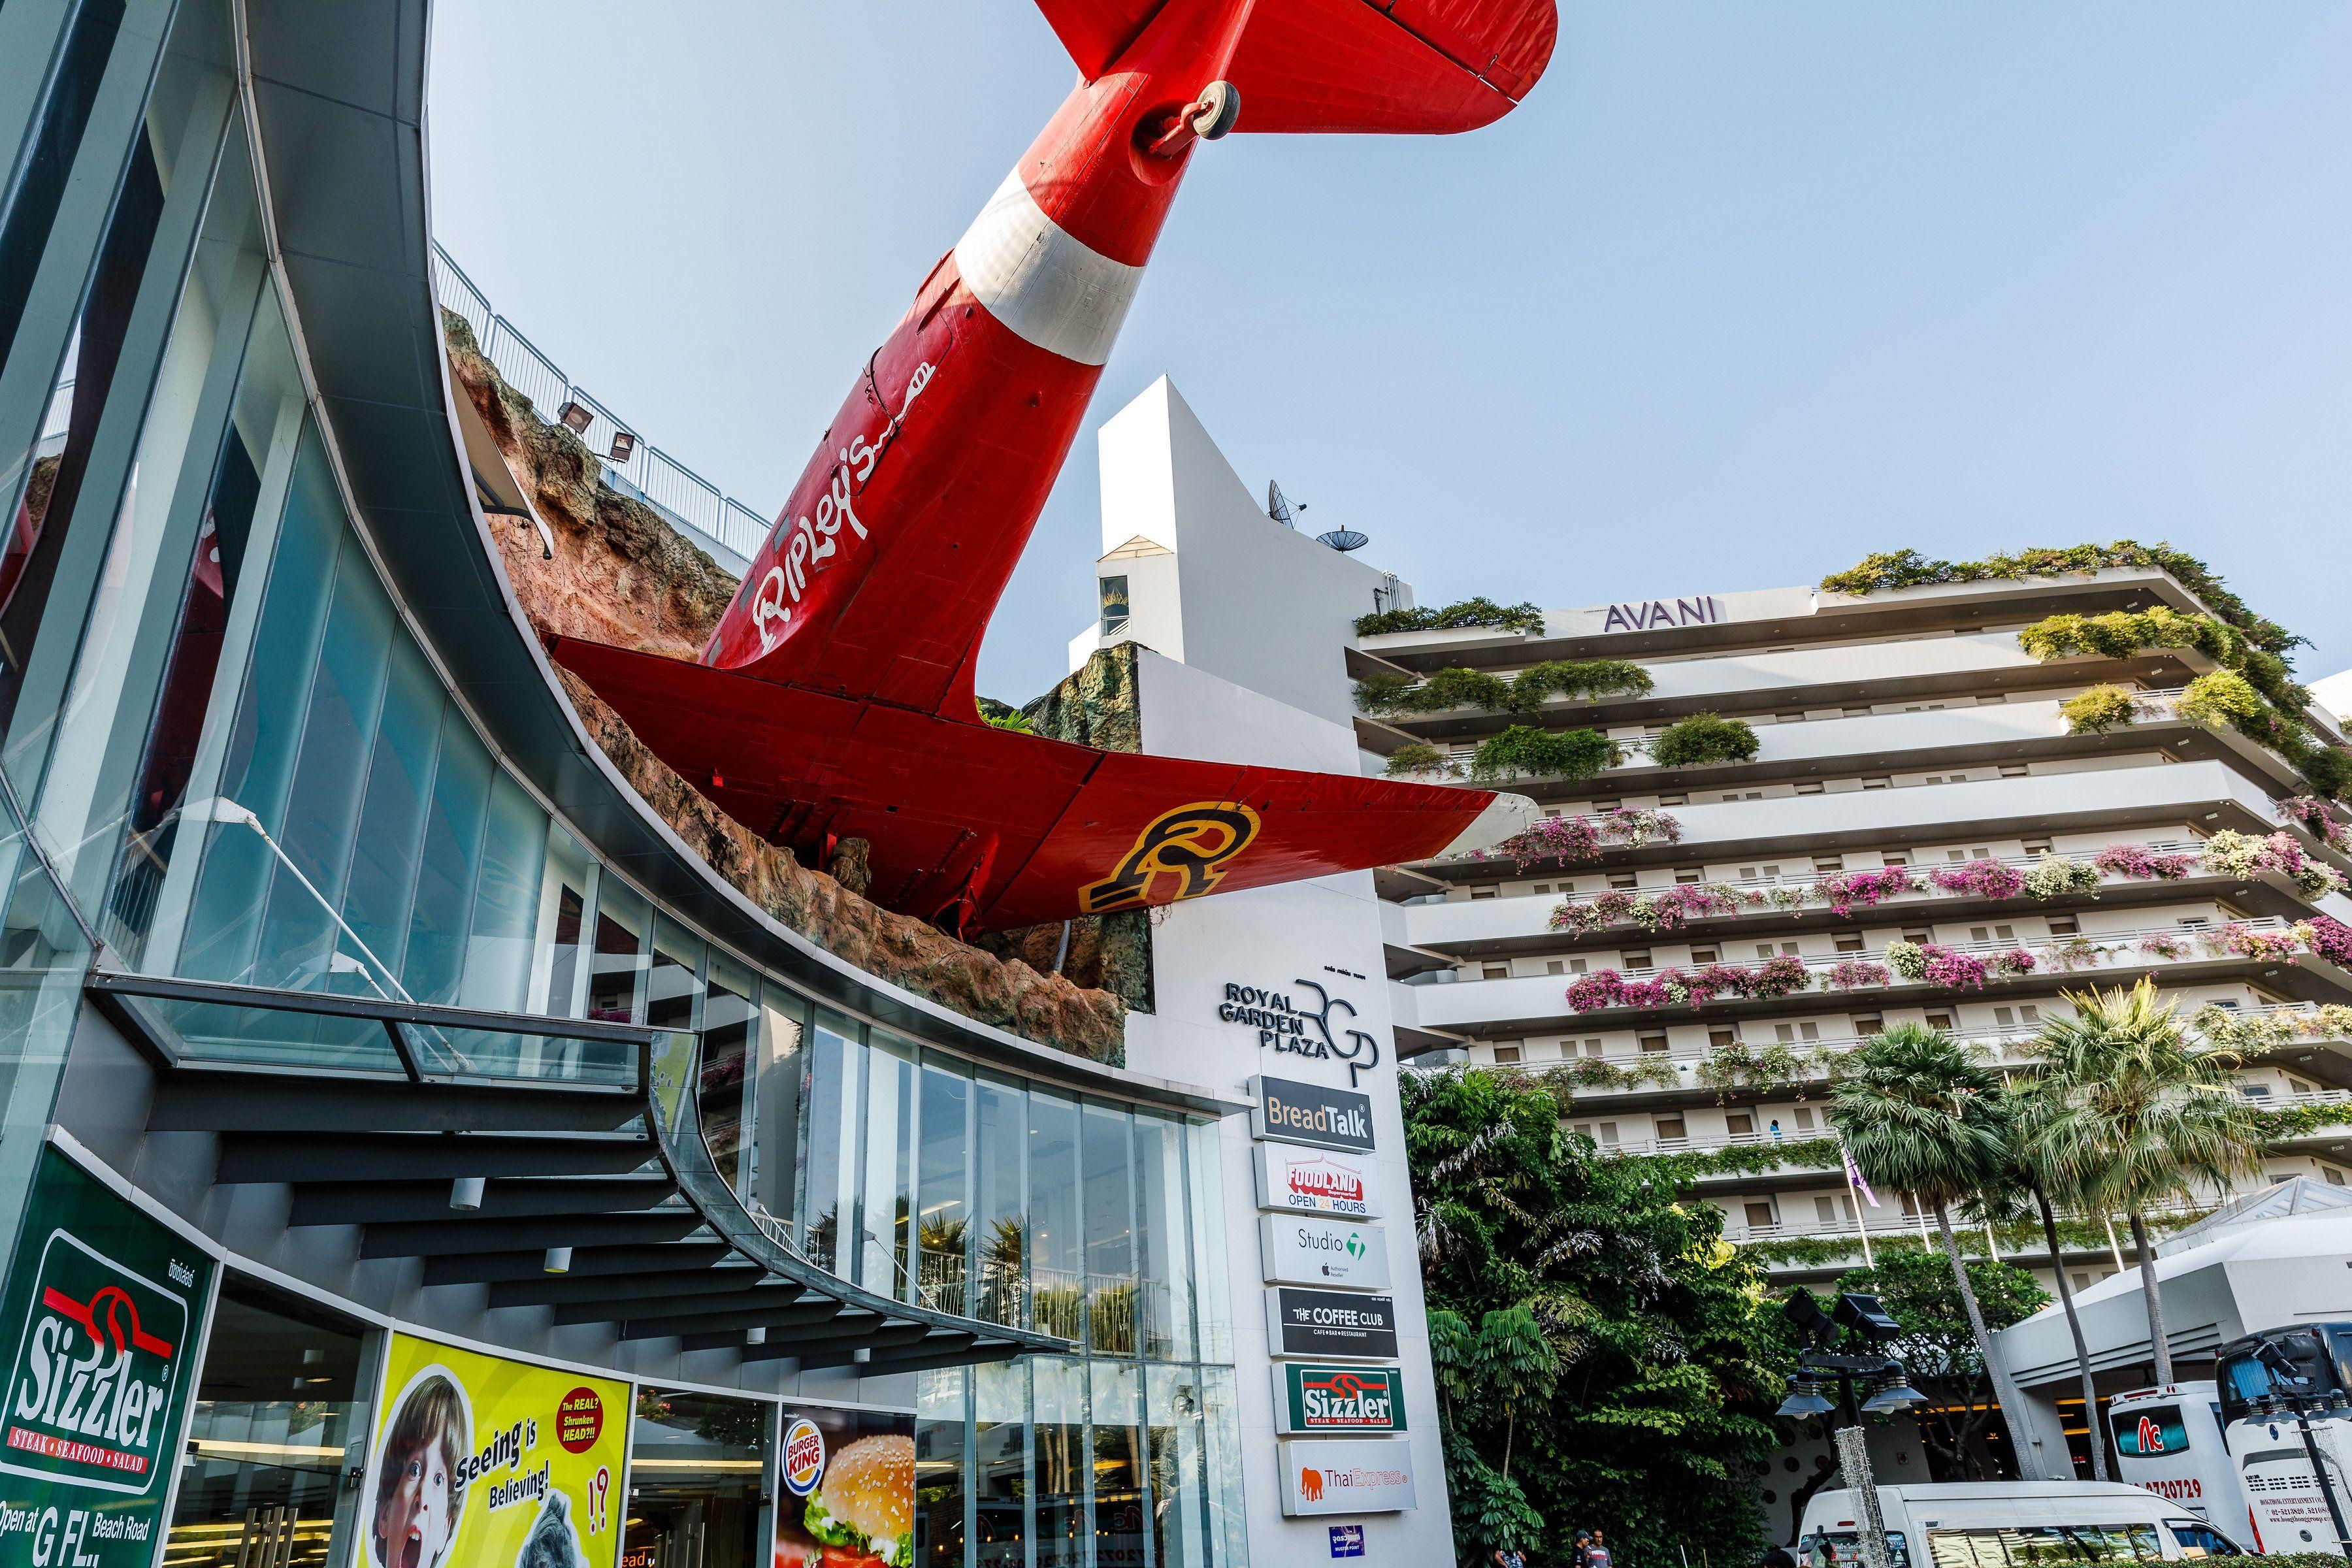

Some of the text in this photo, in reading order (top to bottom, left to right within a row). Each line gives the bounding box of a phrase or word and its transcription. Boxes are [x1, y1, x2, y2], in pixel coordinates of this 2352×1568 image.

[1604, 595, 1716, 632] AVANI
[1226, 982, 1298, 1014] ROYAL
[1219, 1002, 1304, 1036] GARDEN
[1260, 1030, 1330, 1060] PLAZA
[1268, 1096, 1368, 1138] BreadTalk
[1287, 1168, 1358, 1193] FOODLAND
[1328, 1189, 1358, 1198] Supermarket
[1288, 1194, 1367, 1214] OPEN 24 HOURS
[1298, 1228, 1343, 1252] Studio
[1330, 1264, 1349, 1273] Authorised
[1292, 1307, 1384, 1326] THE COFFEE CLUB
[14, 1315, 164, 1448] Sizzler
[563, 1397, 599, 1411] The REAL?
[1305, 1389, 1389, 1418] Sizzler
[563, 1415, 595, 1426] Shrunken
[563, 1427, 596, 1442] HEAD?!!
[12, 1428, 144, 1472] STEAK SEAFOOD SALAD
[454, 1417, 536, 1489] Seeing is
[788, 1435, 819, 1460] BURGER
[789, 1446, 820, 1478] KING
[489, 1460, 549, 1509] Believing!
[1324, 1467, 1402, 1491] ThaiExpress
[25, 1507, 39, 1533] at
[33, 1506, 58, 1568] G
[92, 1512, 151, 1541] Beach Road
